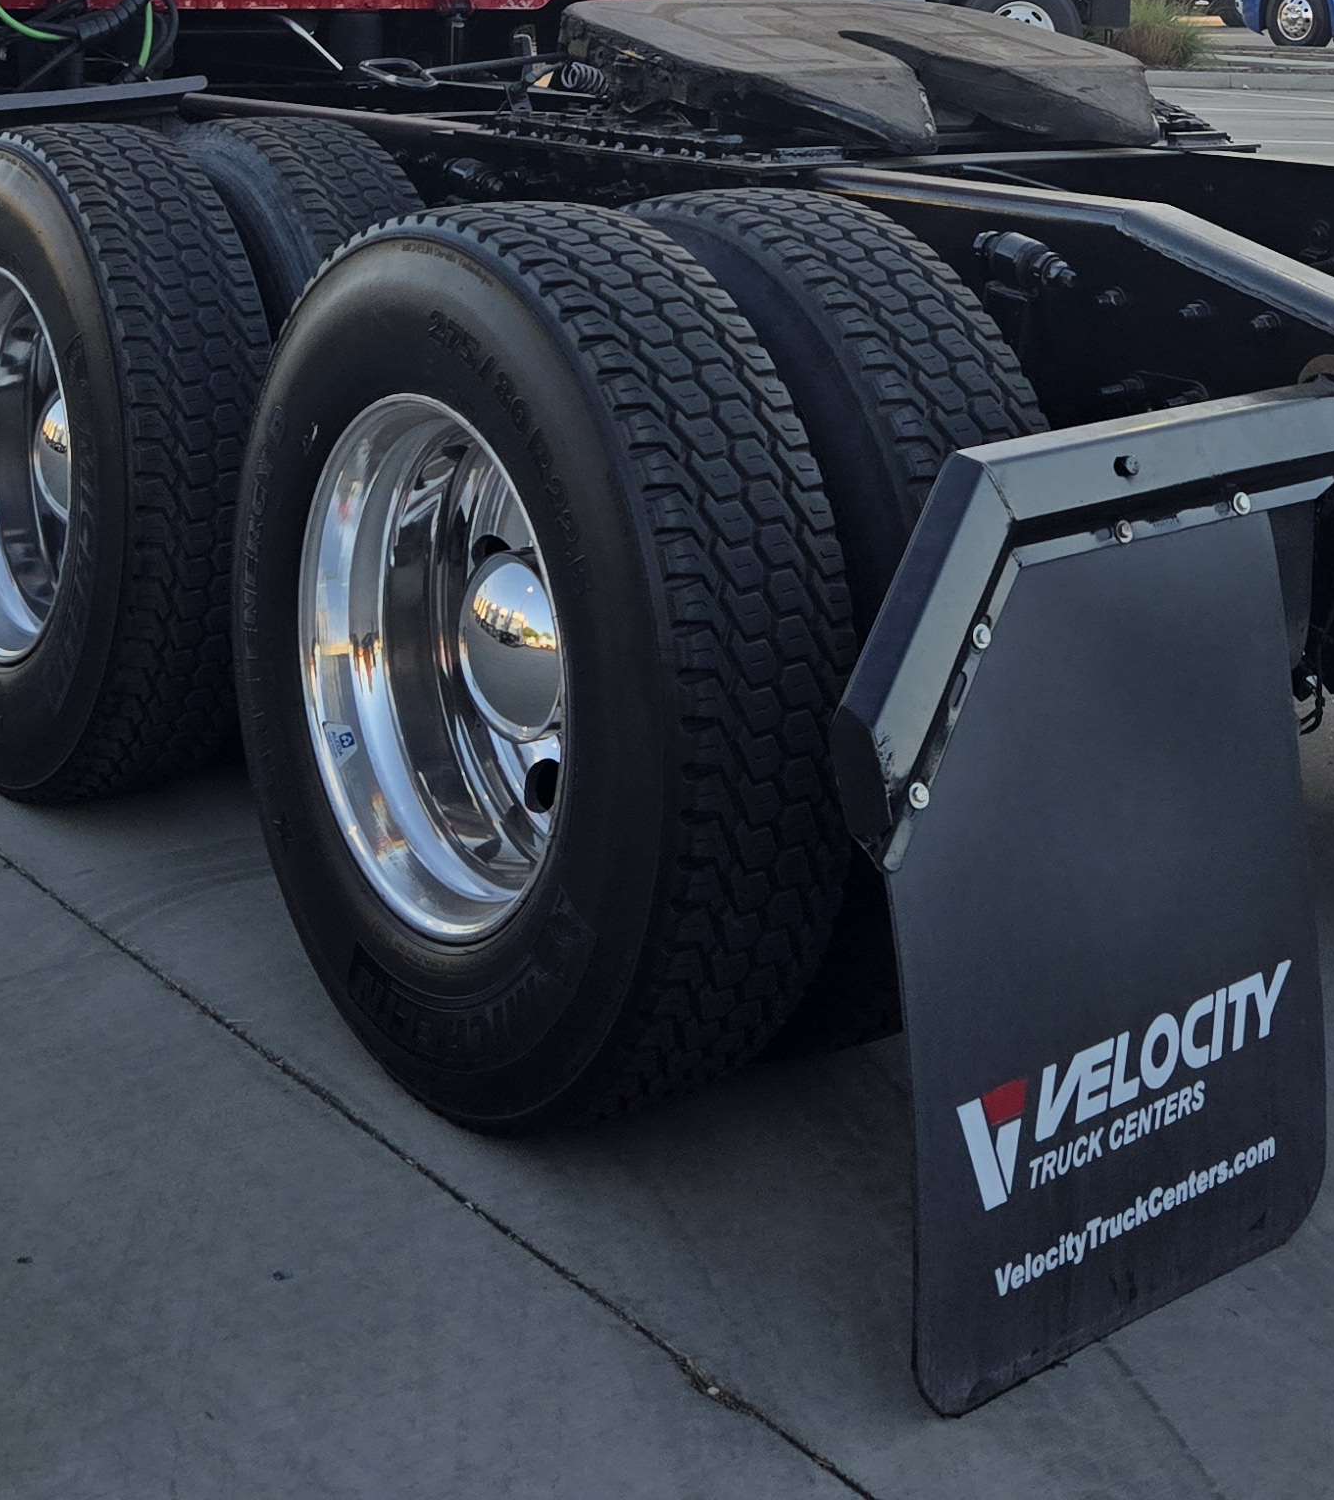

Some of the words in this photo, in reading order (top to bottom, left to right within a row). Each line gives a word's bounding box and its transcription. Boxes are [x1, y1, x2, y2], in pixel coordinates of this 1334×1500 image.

[1035, 959, 1292, 1142] VELOCITY
[994, 1135, 1276, 1297] VelocityTruckCenters.com
[1029, 1126, 1105, 1190] TRUCK
[1108, 1080, 1206, 1151] CENTERS
